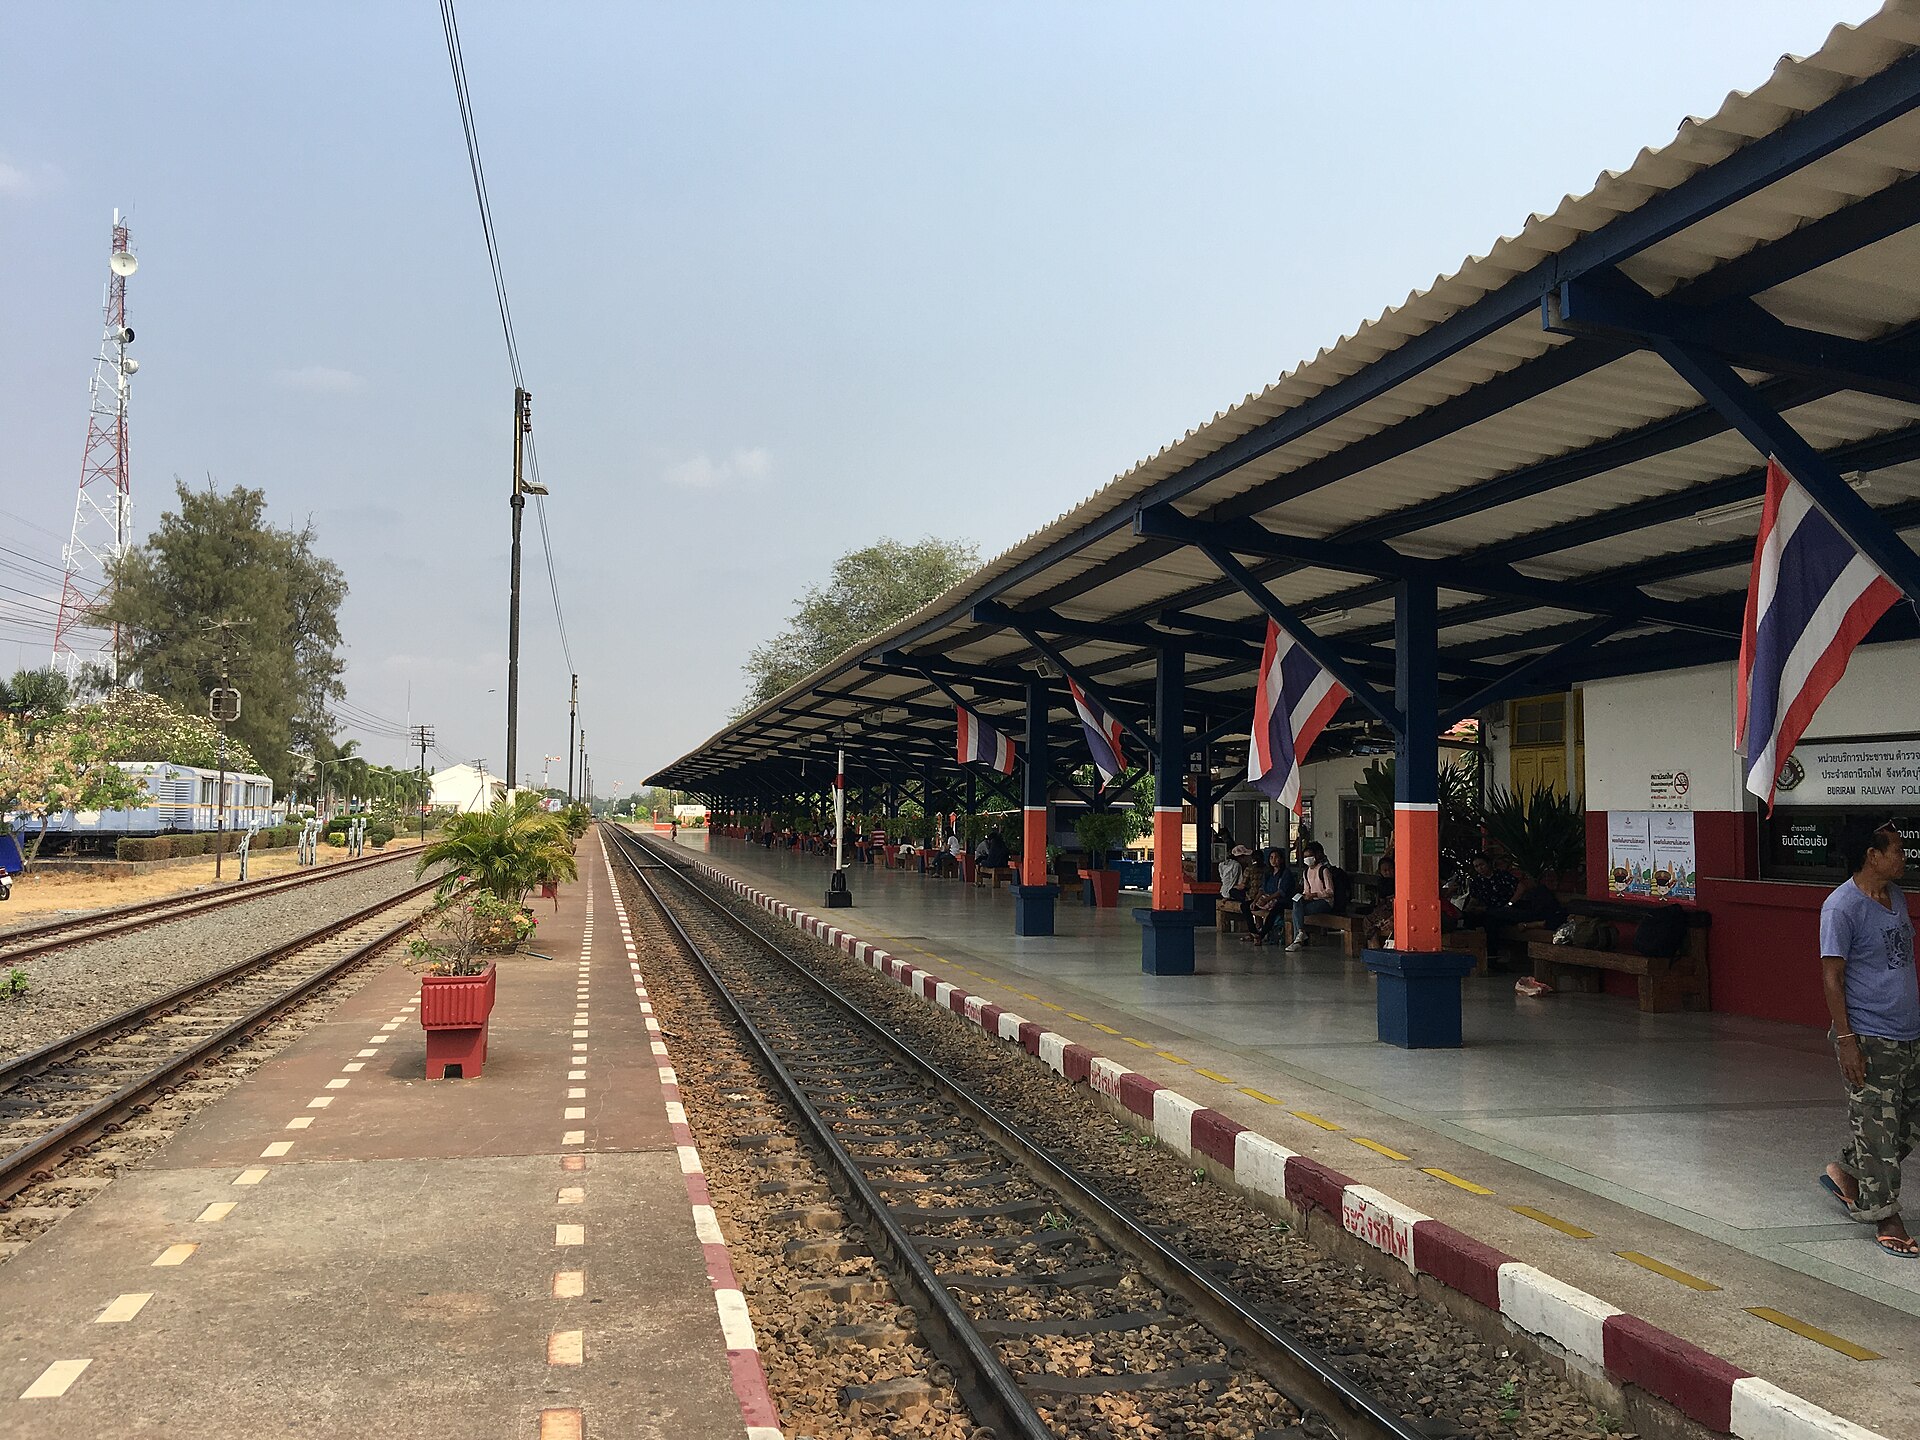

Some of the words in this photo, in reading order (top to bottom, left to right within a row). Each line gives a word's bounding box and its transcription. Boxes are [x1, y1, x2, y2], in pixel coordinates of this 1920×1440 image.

[1817, 752, 1894, 763] หน่วยบริการประชาชน
[1821, 767, 1882, 779] ประจำสถานีรถไฟ
[1827, 786, 1856, 795] BURIRAM
[1861, 786, 1896, 795] RAILWAY
[1781, 834, 1828, 847] ยินดีต้อนรับ
[1344, 1201, 1409, 1257] ระวังรถไฟ
